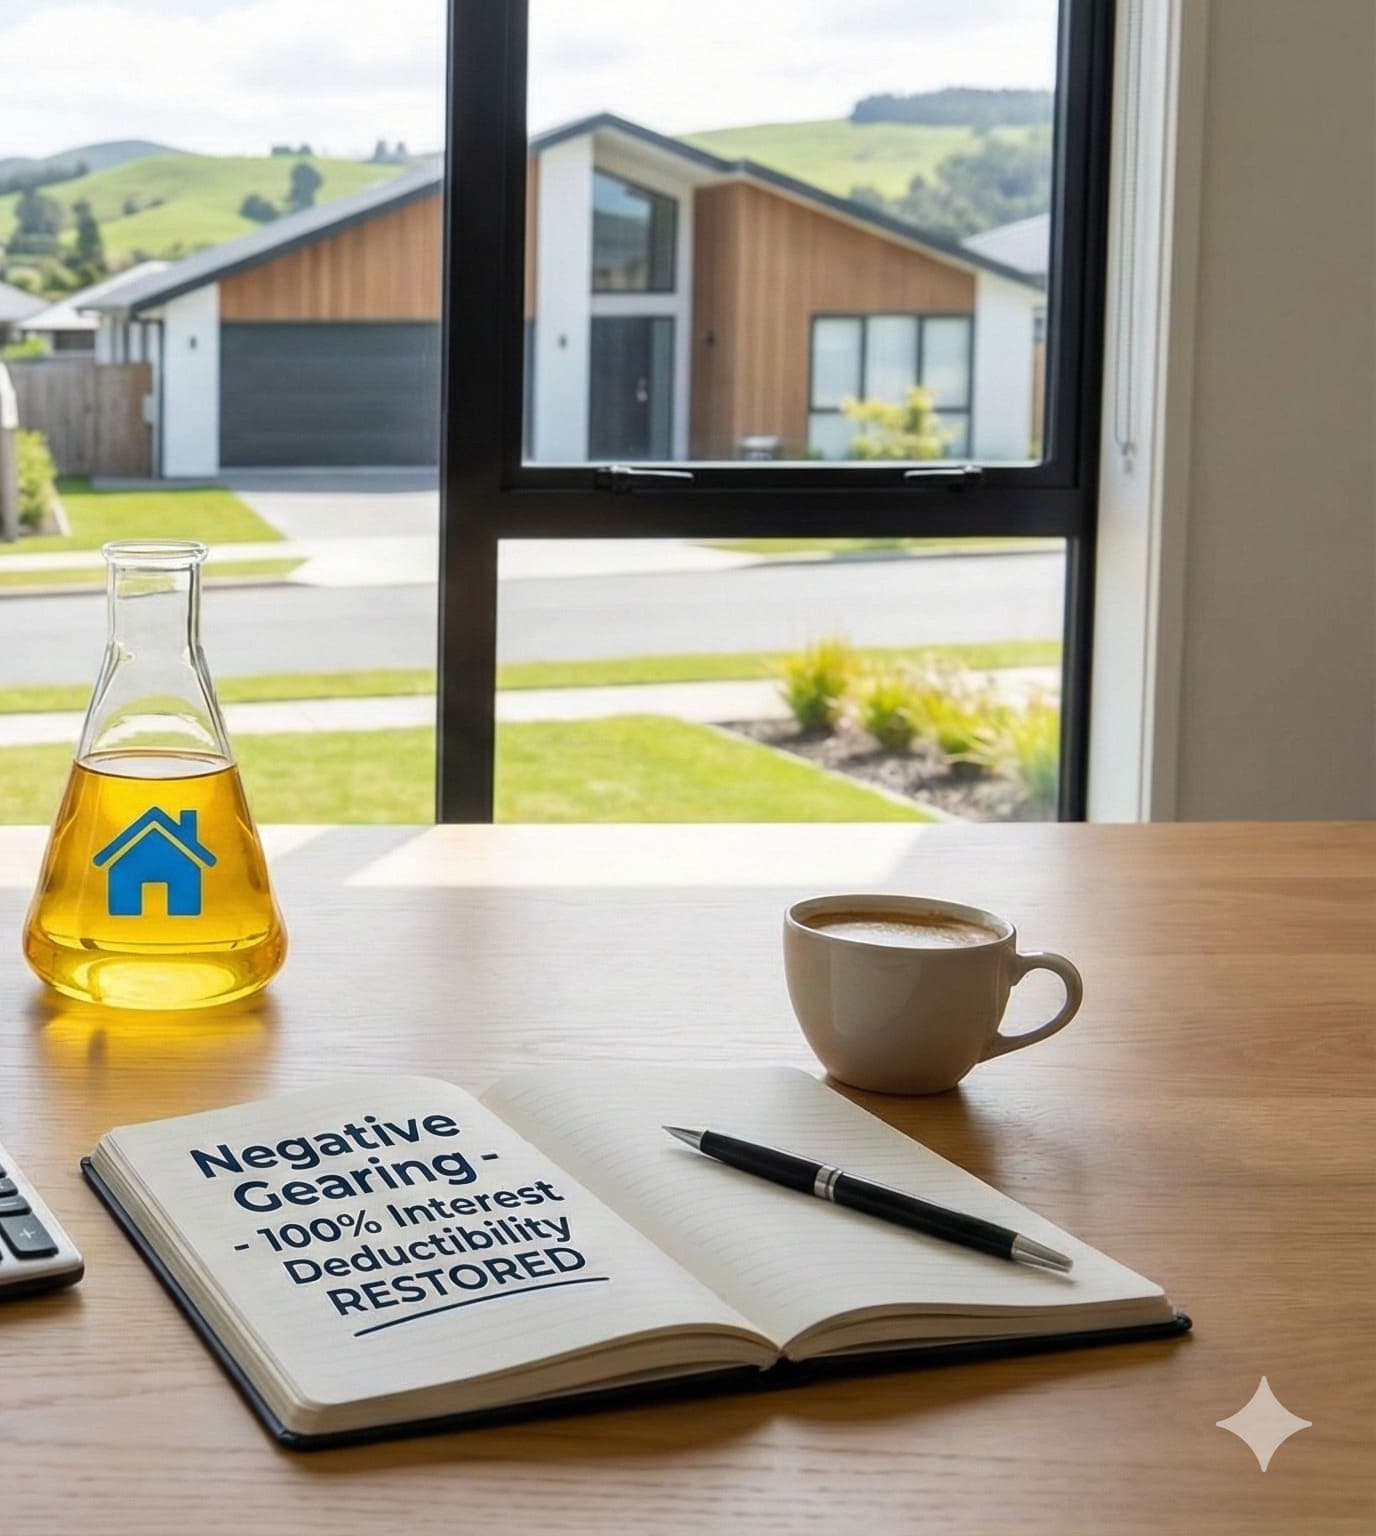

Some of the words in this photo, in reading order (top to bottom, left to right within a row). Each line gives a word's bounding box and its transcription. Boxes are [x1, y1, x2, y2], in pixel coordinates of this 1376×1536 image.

[190, 1114, 461, 1178] Negative
[233, 1148, 478, 1213] Gearing
[256, 1208, 382, 1252] 100%
[387, 1180, 564, 1228] Interest
[283, 1216, 571, 1286] Deductibility
[326, 1247, 587, 1316] RESTORED
